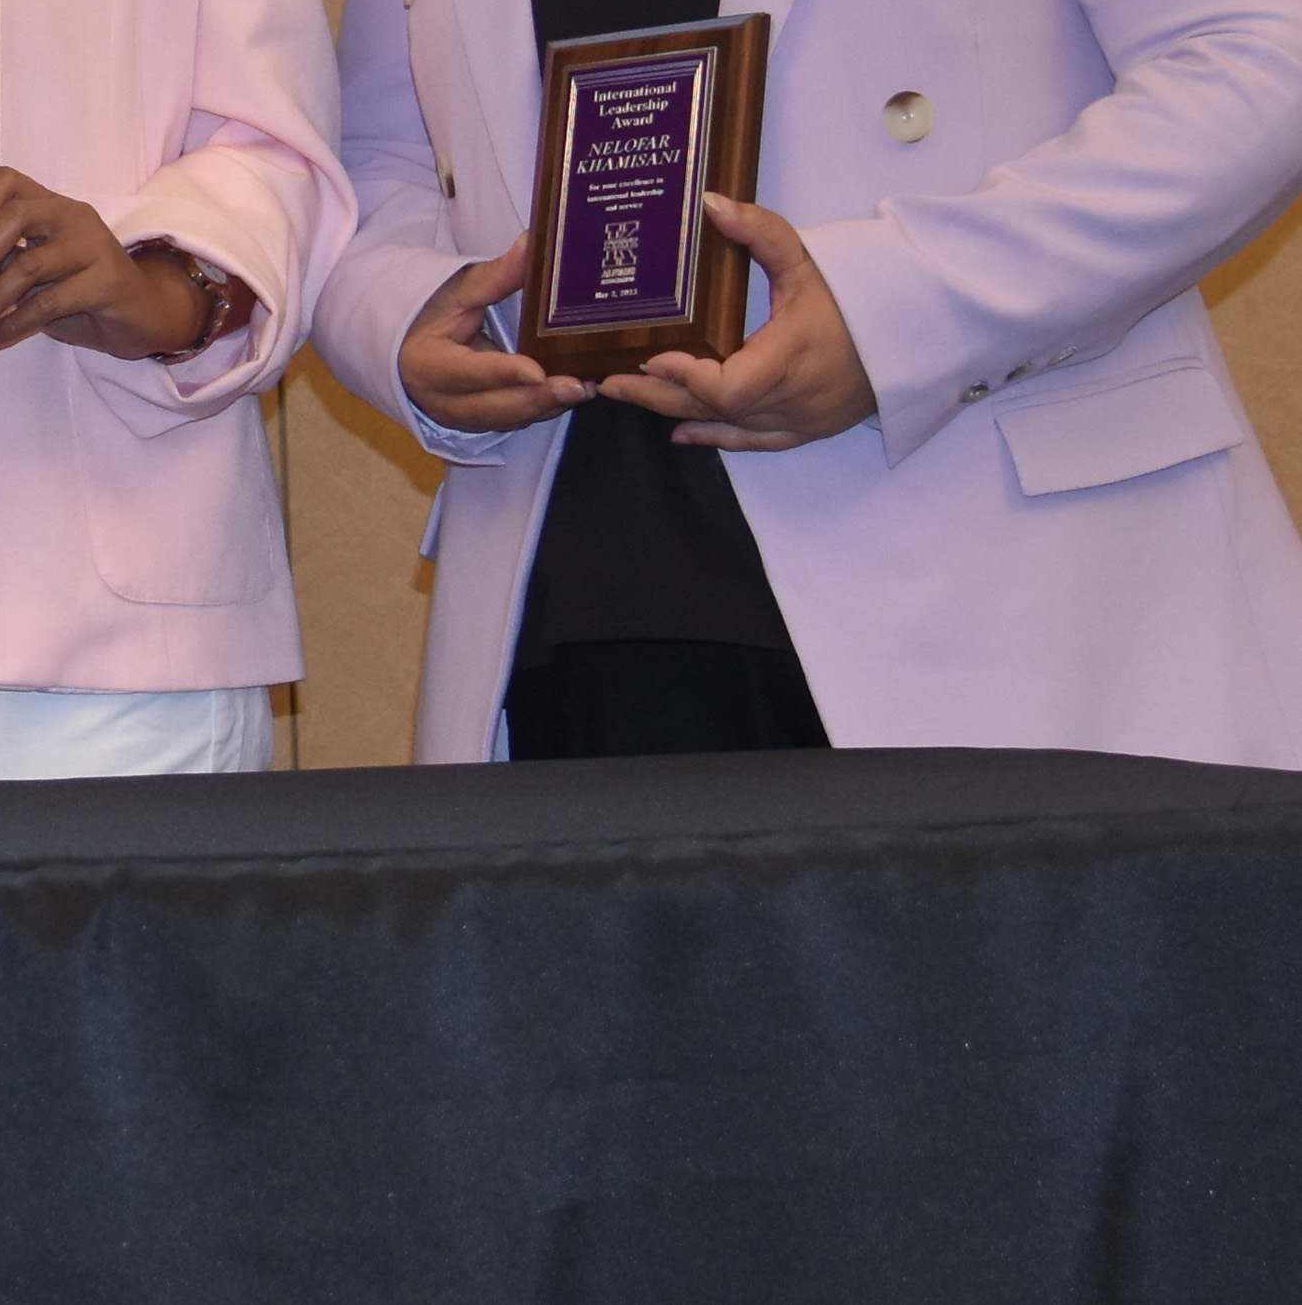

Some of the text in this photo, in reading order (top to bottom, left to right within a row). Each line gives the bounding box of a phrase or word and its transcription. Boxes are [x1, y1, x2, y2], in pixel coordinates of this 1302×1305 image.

[594, 81, 677, 103] International
[599, 97, 669, 117] Leadership
[611, 112, 654, 130] Award
[587, 134, 670, 157] NELOFAR
[576, 149, 681, 174] KHAMISANI
